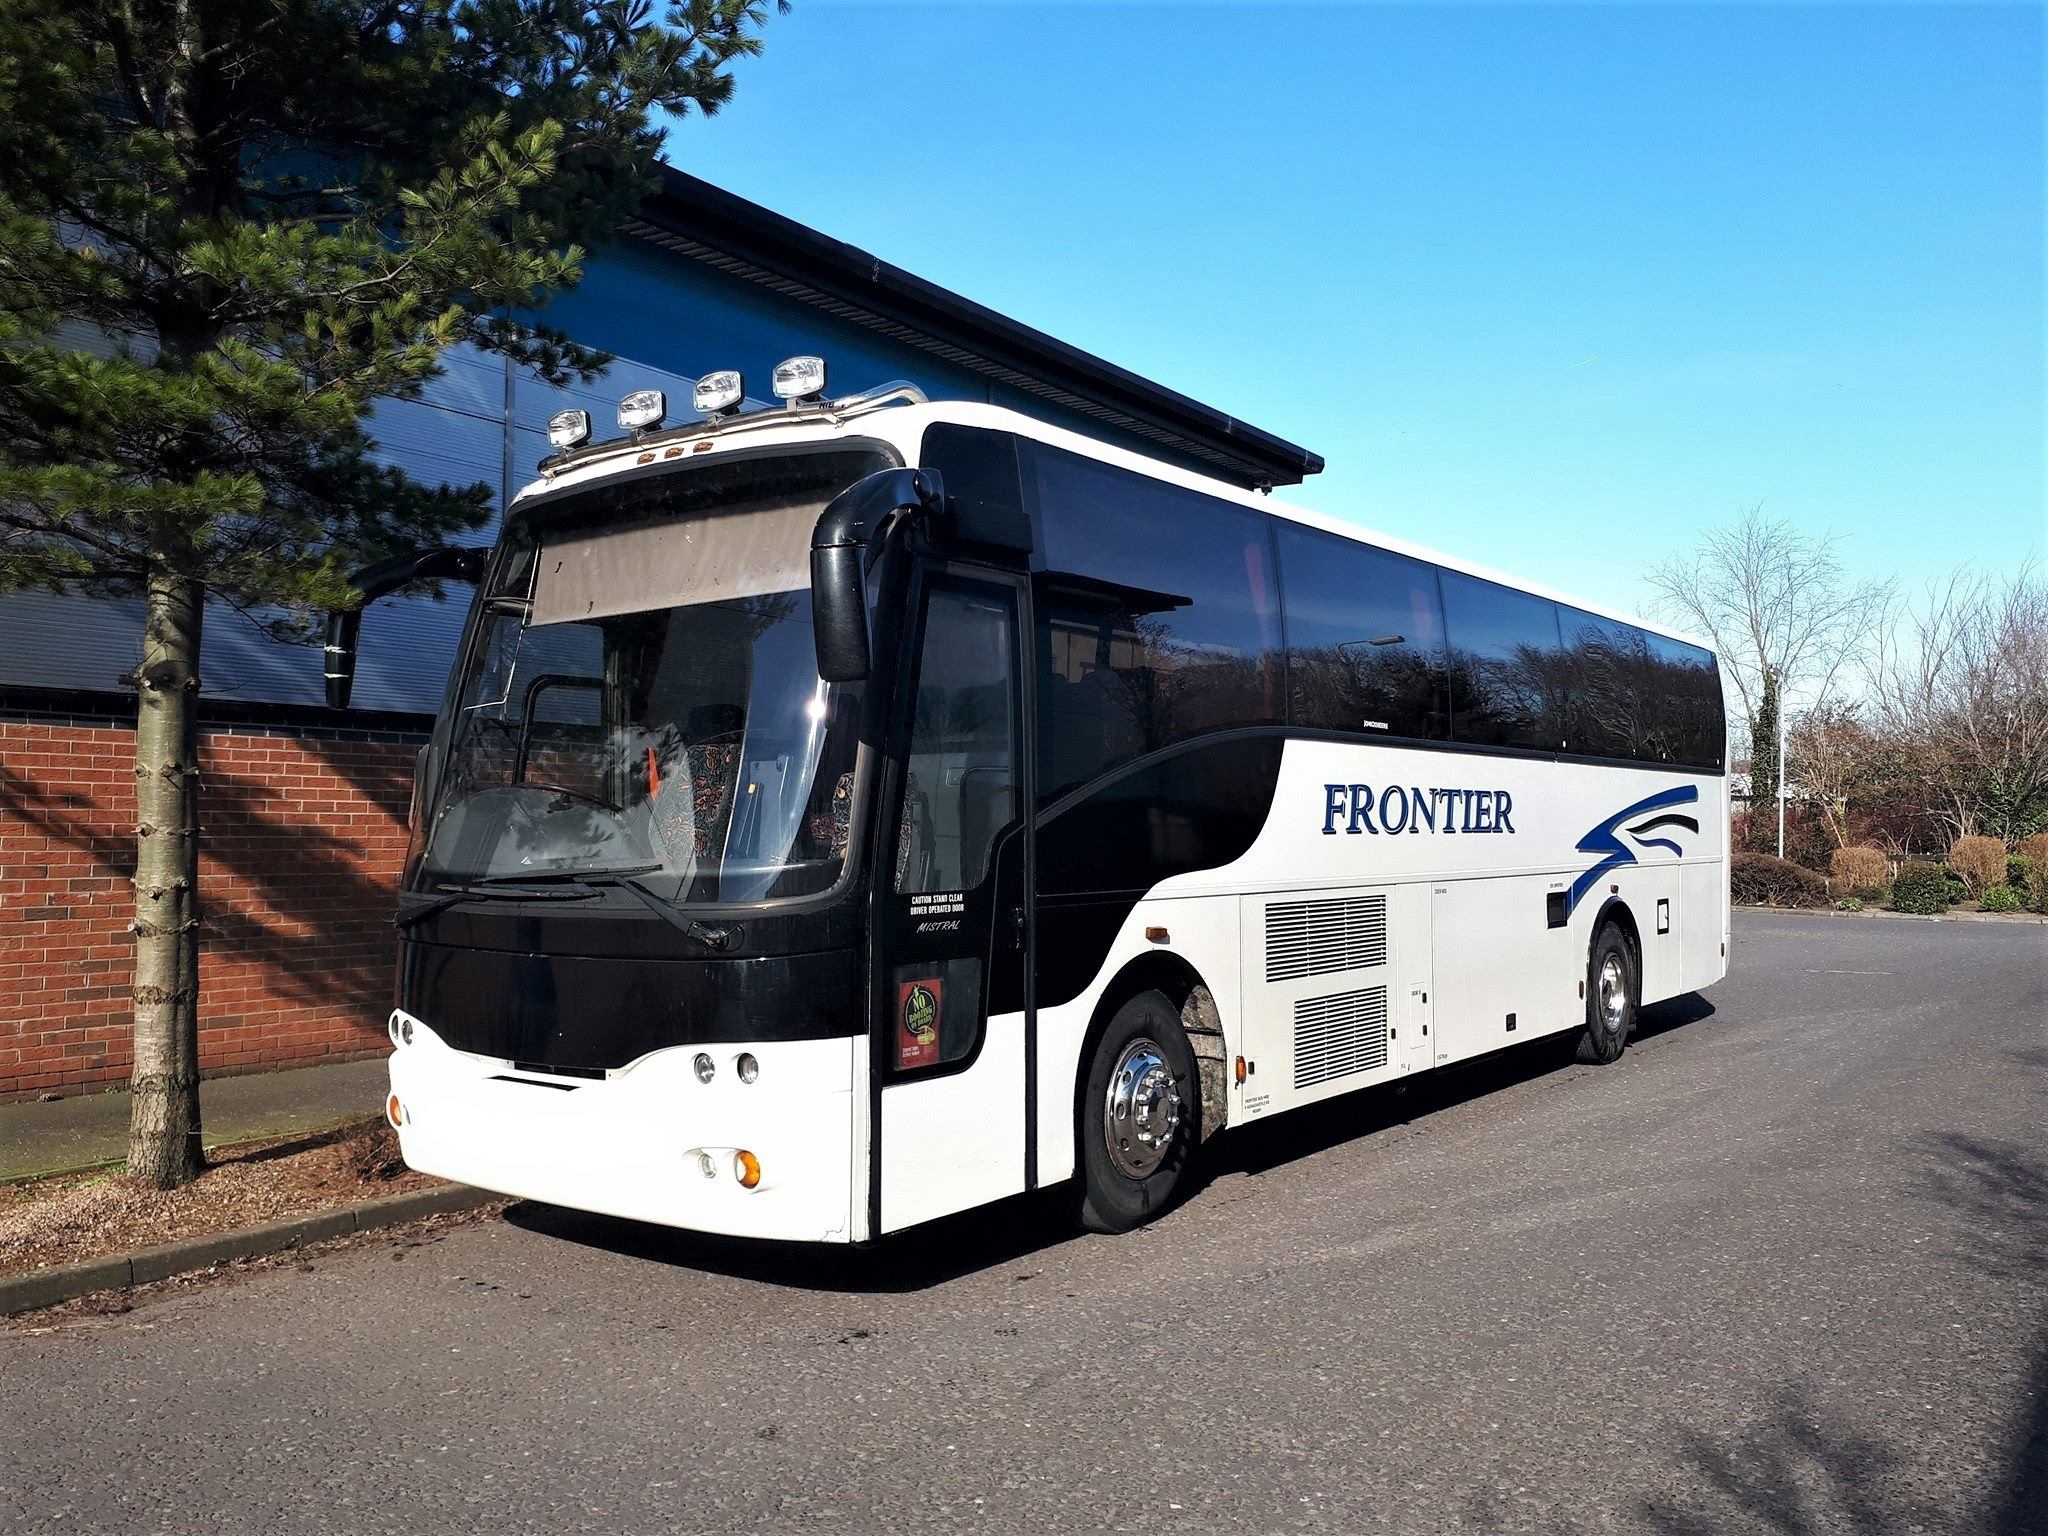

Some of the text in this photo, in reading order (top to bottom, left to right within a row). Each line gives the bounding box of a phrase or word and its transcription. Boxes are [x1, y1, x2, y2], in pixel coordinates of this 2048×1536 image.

[1321, 784, 1516, 835] FRONTIER
[912, 893, 963, 904] CAUTION STAND CLEAR
[910, 903, 965, 915] DRIVER OPERATED DOOR
[916, 919, 961, 934] MISTRAL
[912, 994, 926, 1012] NO
